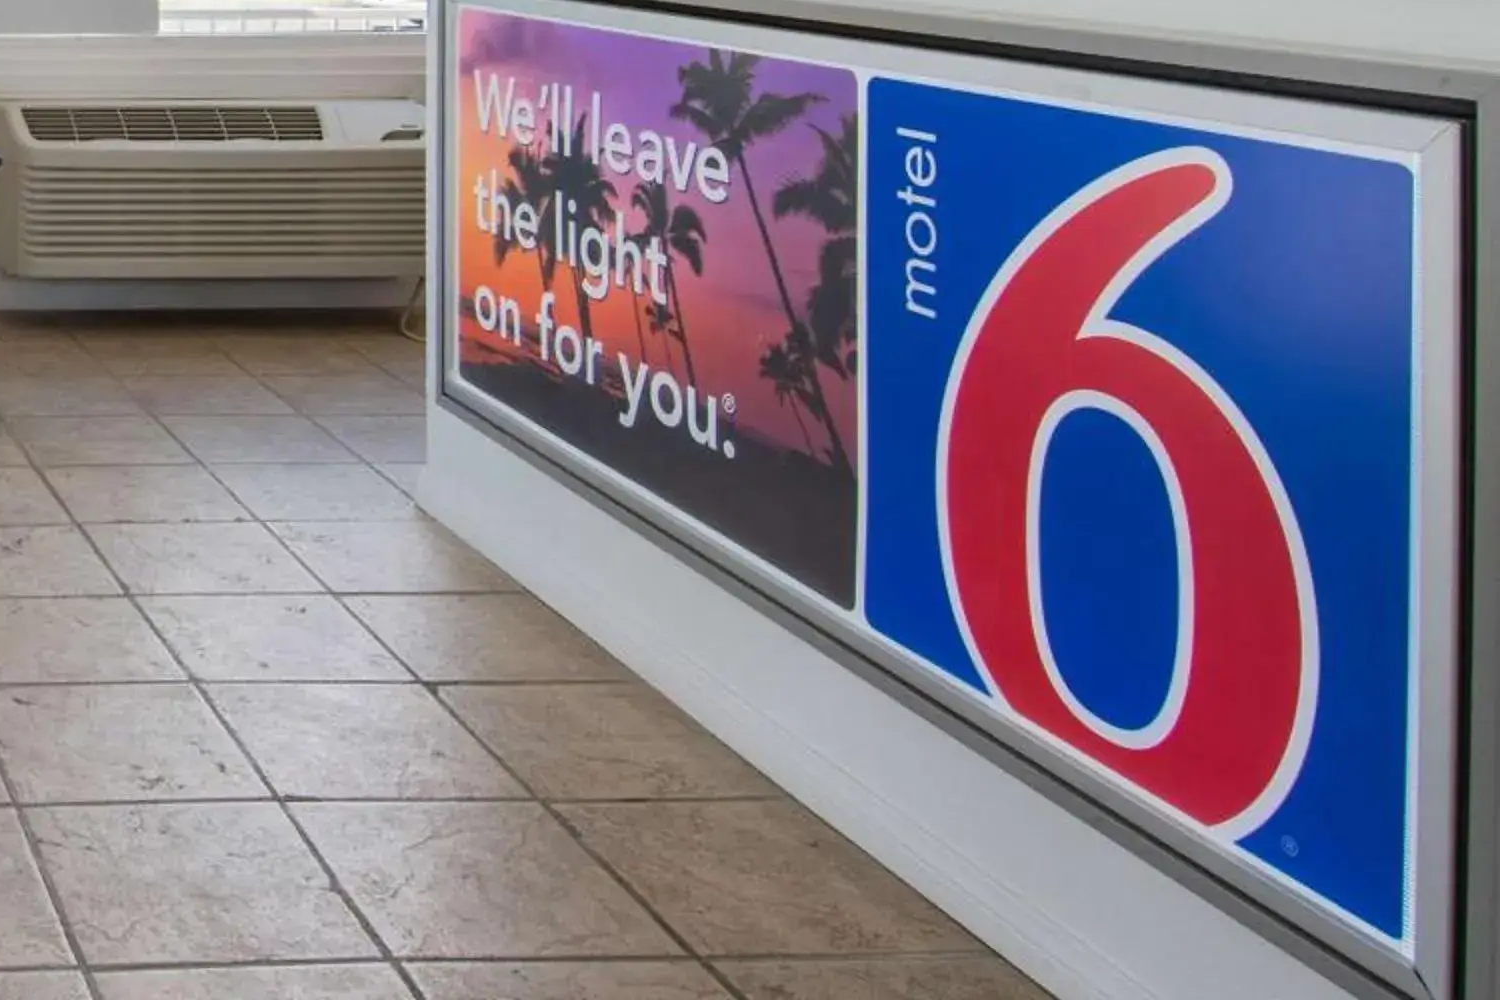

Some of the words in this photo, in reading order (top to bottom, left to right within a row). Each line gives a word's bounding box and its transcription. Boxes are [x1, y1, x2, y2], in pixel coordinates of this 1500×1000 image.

[473, 67, 573, 158] We'll
[592, 90, 731, 204] leave
[473, 168, 539, 250] the
[554, 189, 669, 306] light
[896, 125, 938, 320] motel
[474, 285, 522, 348] on
[535, 291, 604, 385] for
[934, 144, 1321, 846] 6
